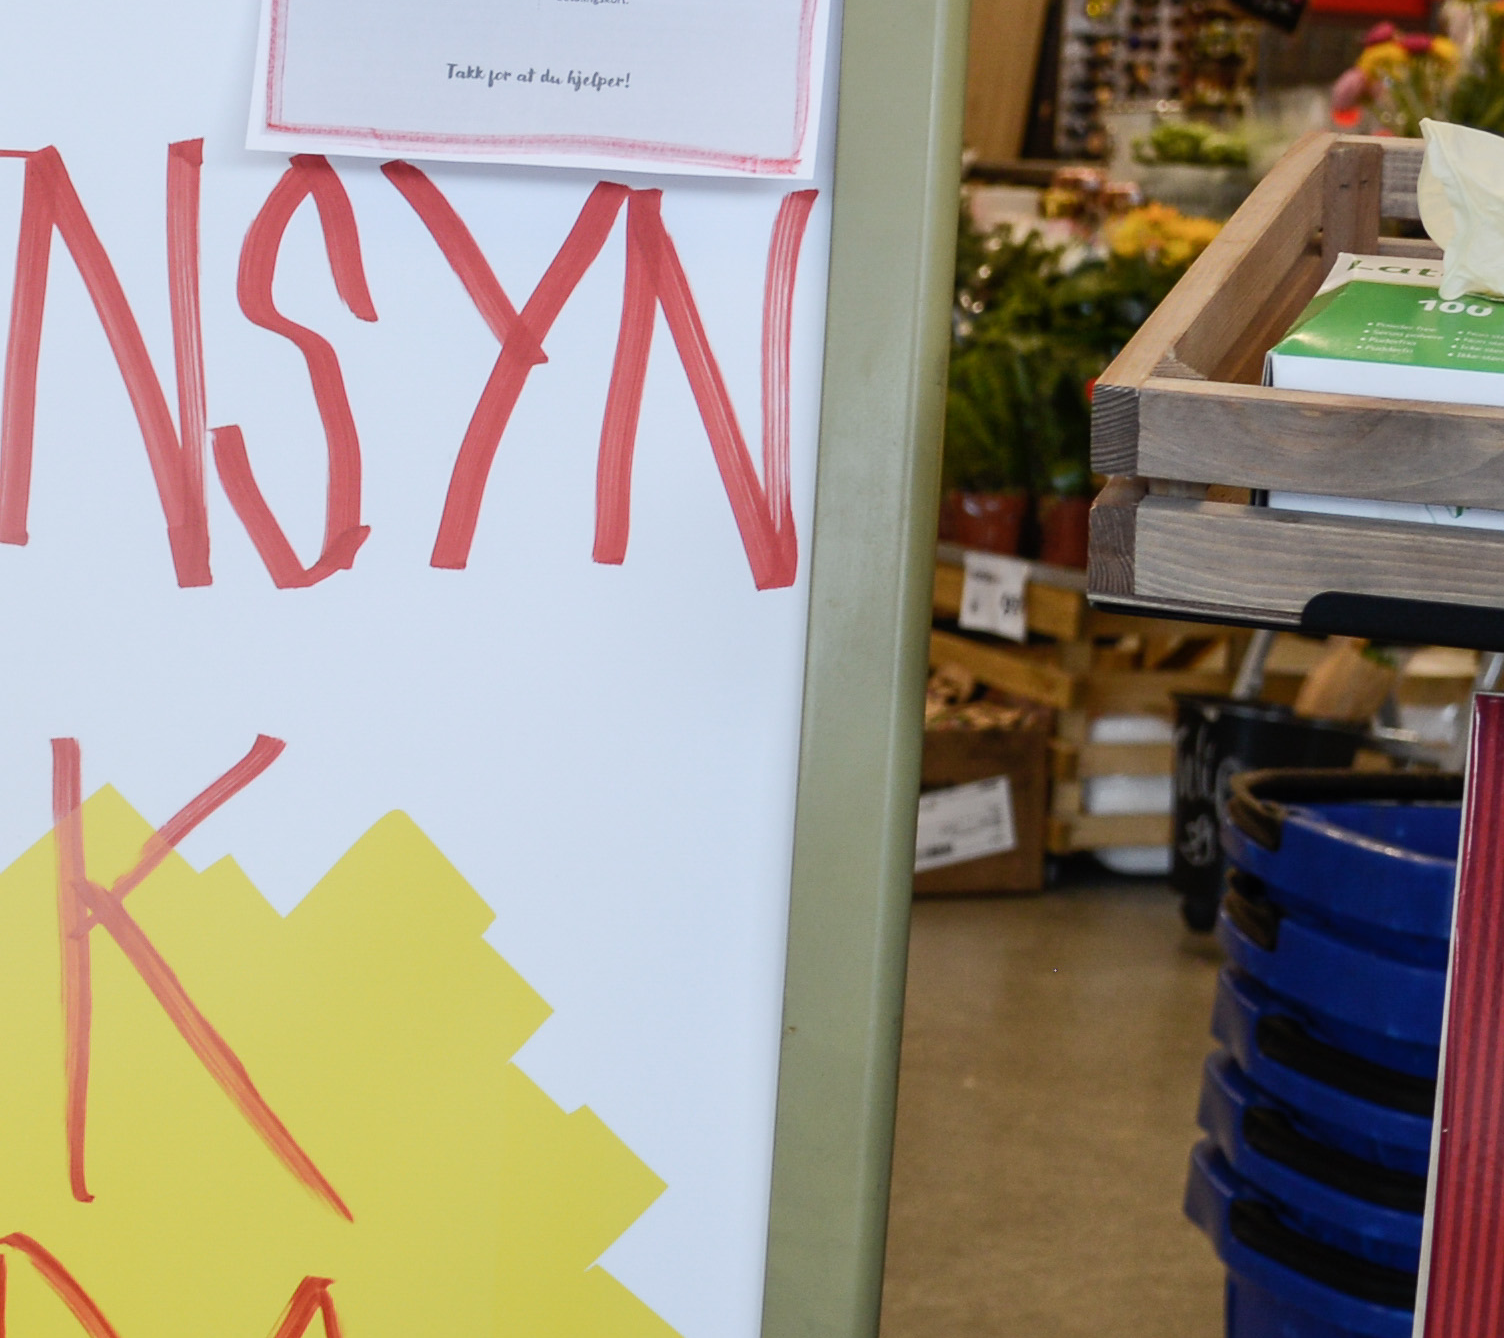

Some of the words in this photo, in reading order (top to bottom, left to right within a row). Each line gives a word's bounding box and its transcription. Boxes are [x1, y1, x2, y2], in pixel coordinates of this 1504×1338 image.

[447, 63, 486, 80] Takk
[488, 69, 513, 89] for
[516, 68, 537, 83] at
[540, 68, 563, 86] du
[567, 70, 631, 92] hjelper!
[1417, 299, 1494, 318] 100
